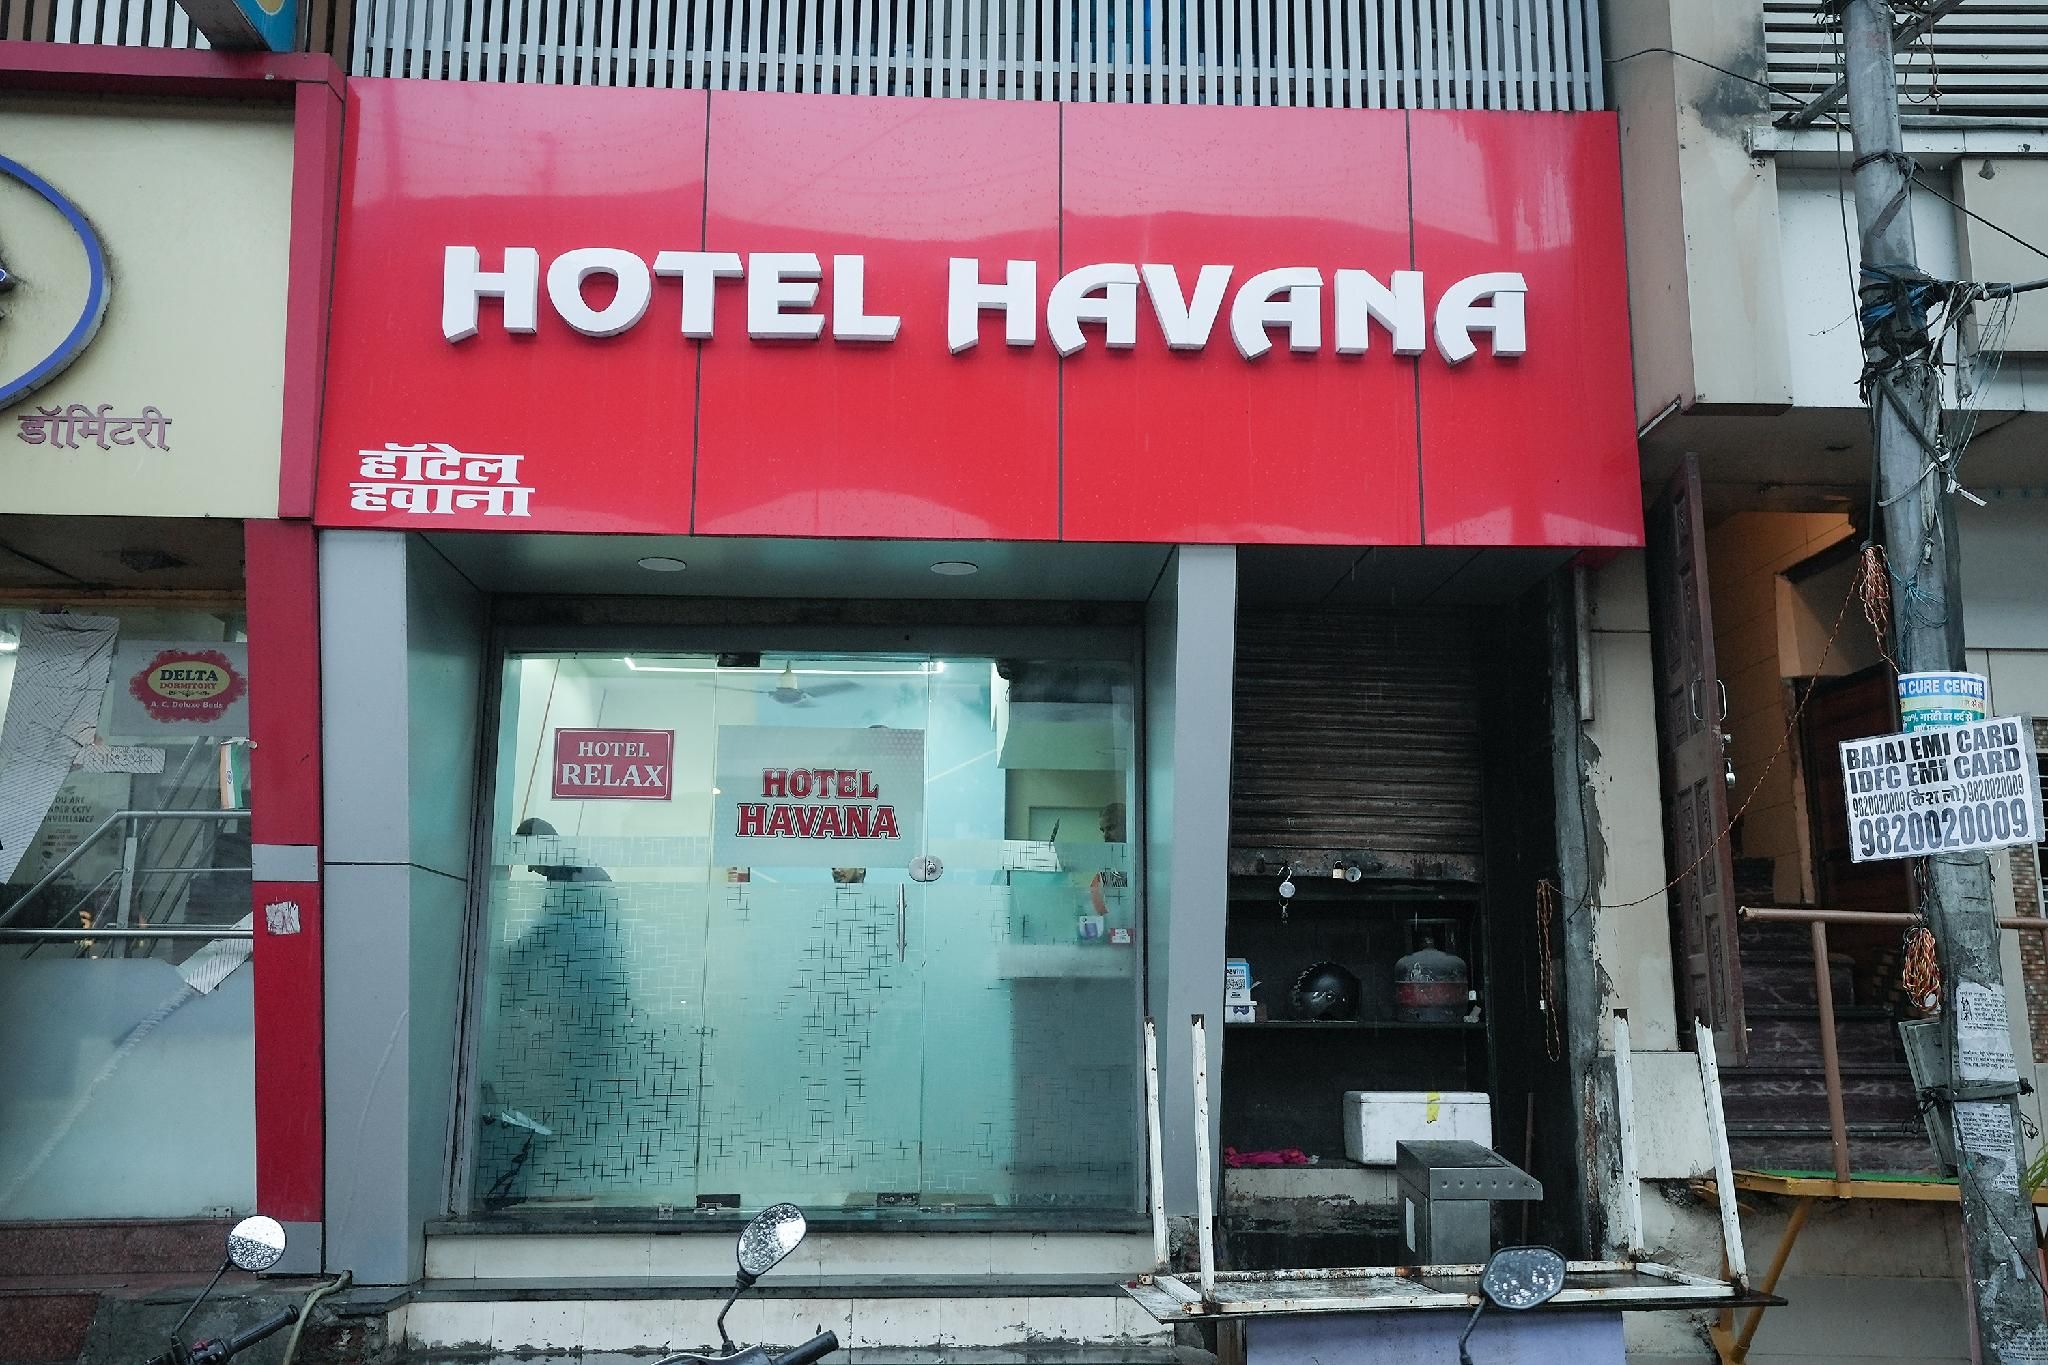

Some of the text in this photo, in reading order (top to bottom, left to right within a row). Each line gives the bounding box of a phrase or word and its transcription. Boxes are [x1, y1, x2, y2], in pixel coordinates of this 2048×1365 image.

[442, 246, 1529, 366] HOTEL HAVANA
[17, 403, 173, 451] डॉर्मिटरी
[358, 442, 525, 484] हॉटेल
[349, 482, 536, 517] हवाना
[160, 669, 219, 682] DELTA
[160, 682, 217, 690] DORMITORY
[1908, 680, 1940, 694] CURE
[1943, 680, 1983, 696] CENTRE
[172, 701, 201, 709] Deluxe
[202, 701, 223, 709] Beds
[578, 741, 650, 758] HOTEL
[1846, 722, 2018, 770] BAJAJ EMI CARD
[561, 763, 664, 787] RELAX
[761, 768, 879, 800] HOTEL
[1850, 748, 2021, 794] IDFC EMI CARD
[736, 803, 901, 840] HAVANA
[1859, 798, 2029, 857] 9820020009
